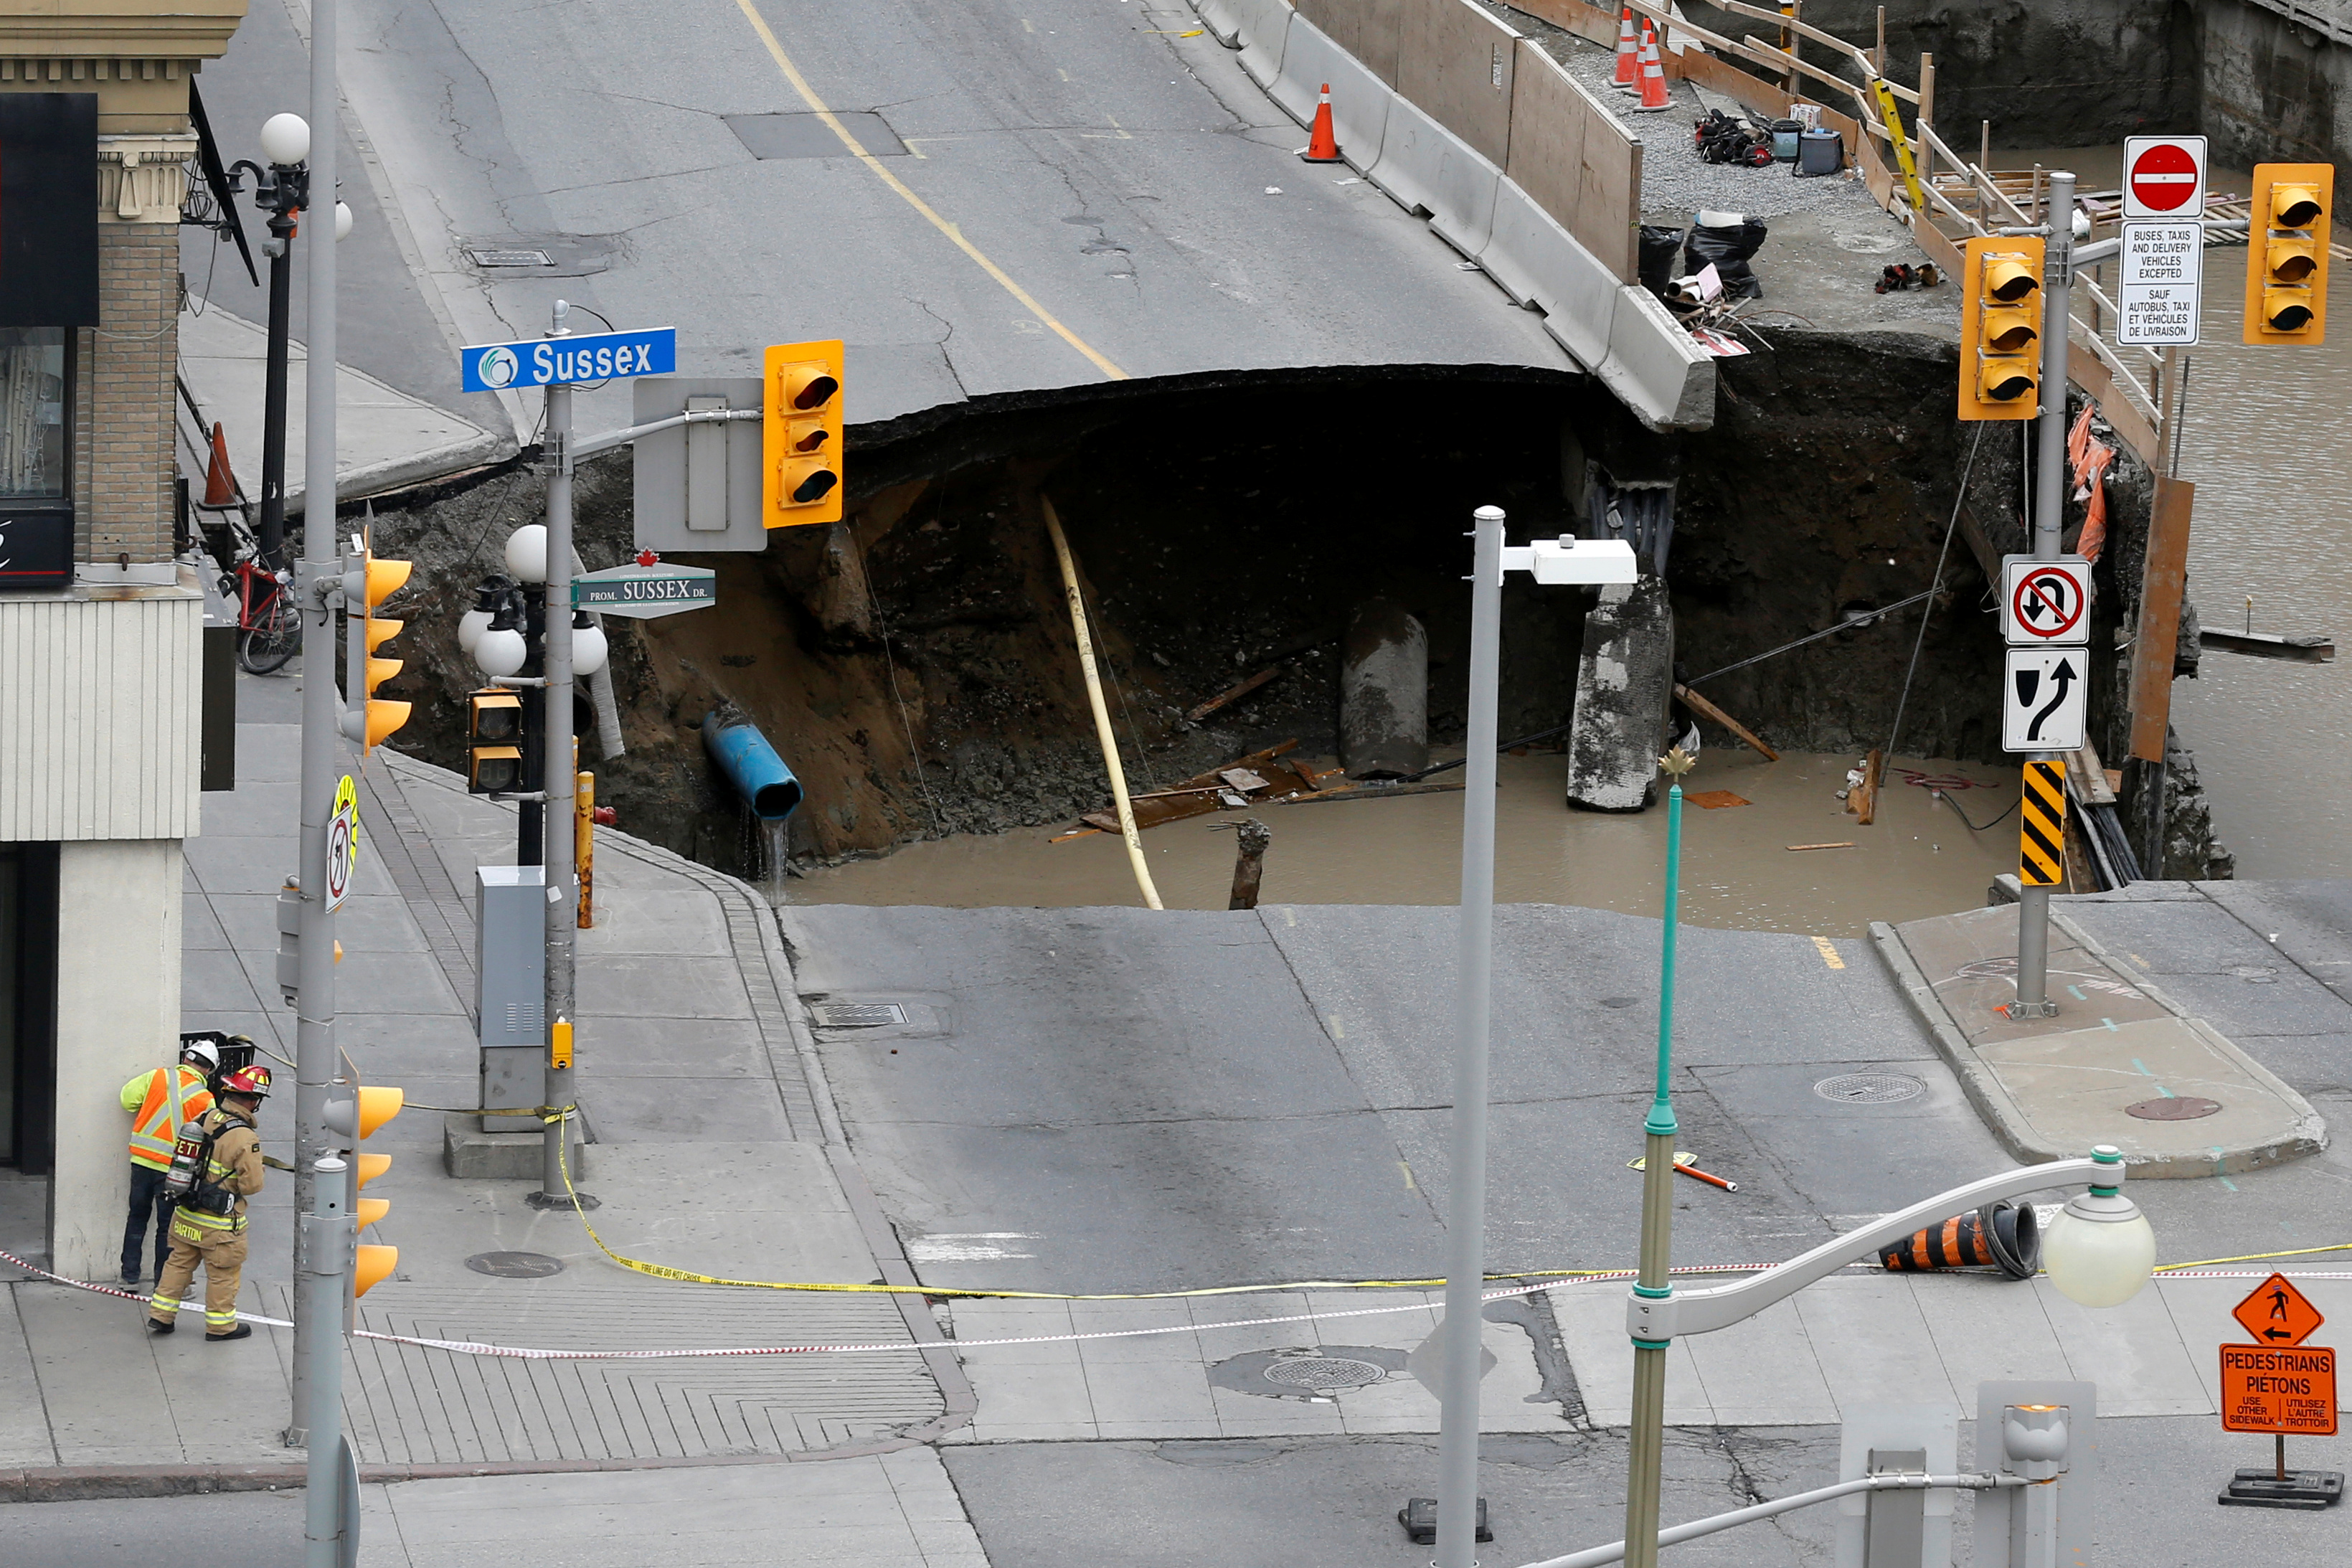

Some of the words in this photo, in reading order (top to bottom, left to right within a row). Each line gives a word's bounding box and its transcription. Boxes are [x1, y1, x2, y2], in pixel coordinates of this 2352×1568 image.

[2134, 230, 2164, 242] BUSES,
[2168, 230, 2191, 240] TAXIS
[2132, 243, 2150, 252] AND
[2153, 243, 2192, 252] DELIVERY
[2141, 256, 2181, 265] VEHICLES
[2139, 268, 2182, 278] EXCEPTED
[2148, 290, 2171, 299] SAUF
[2128, 302, 2169, 313] AUTOBUS,
[2173, 302, 2190, 311] TAXI
[2129, 315, 2139, 324] ET
[2129, 327, 2140, 336] DE
[2143, 326, 2187, 336] LIVRAISON
[533, 343, 652, 384] Sussex
[590, 592, 618, 601] PROM.
[623, 580, 691, 600] SUSSEX
[693, 588, 708, 598] DR.
[174, 1221, 202, 1242] BARTON
[641, 1263, 652, 1273] FIRE
[652, 1265, 663, 1275] LINE
[663, 1268, 671, 1277] DO
[671, 1270, 684, 1280] NOT
[2225, 1352, 2330, 1373] PEDESTRIANS
[2247, 1372, 2310, 1394] PIÉTONS
[2242, 1396, 2261, 1405] USE
[2286, 1399, 2326, 1408] UTILISEZ
[2237, 1406, 2267, 1415] OTHER
[2288, 1408, 2325, 1418] L'AUTRE
[2229, 1414, 2275, 1425] SIDEWALK
[2285, 1417, 2329, 1427] TROTTOIR
